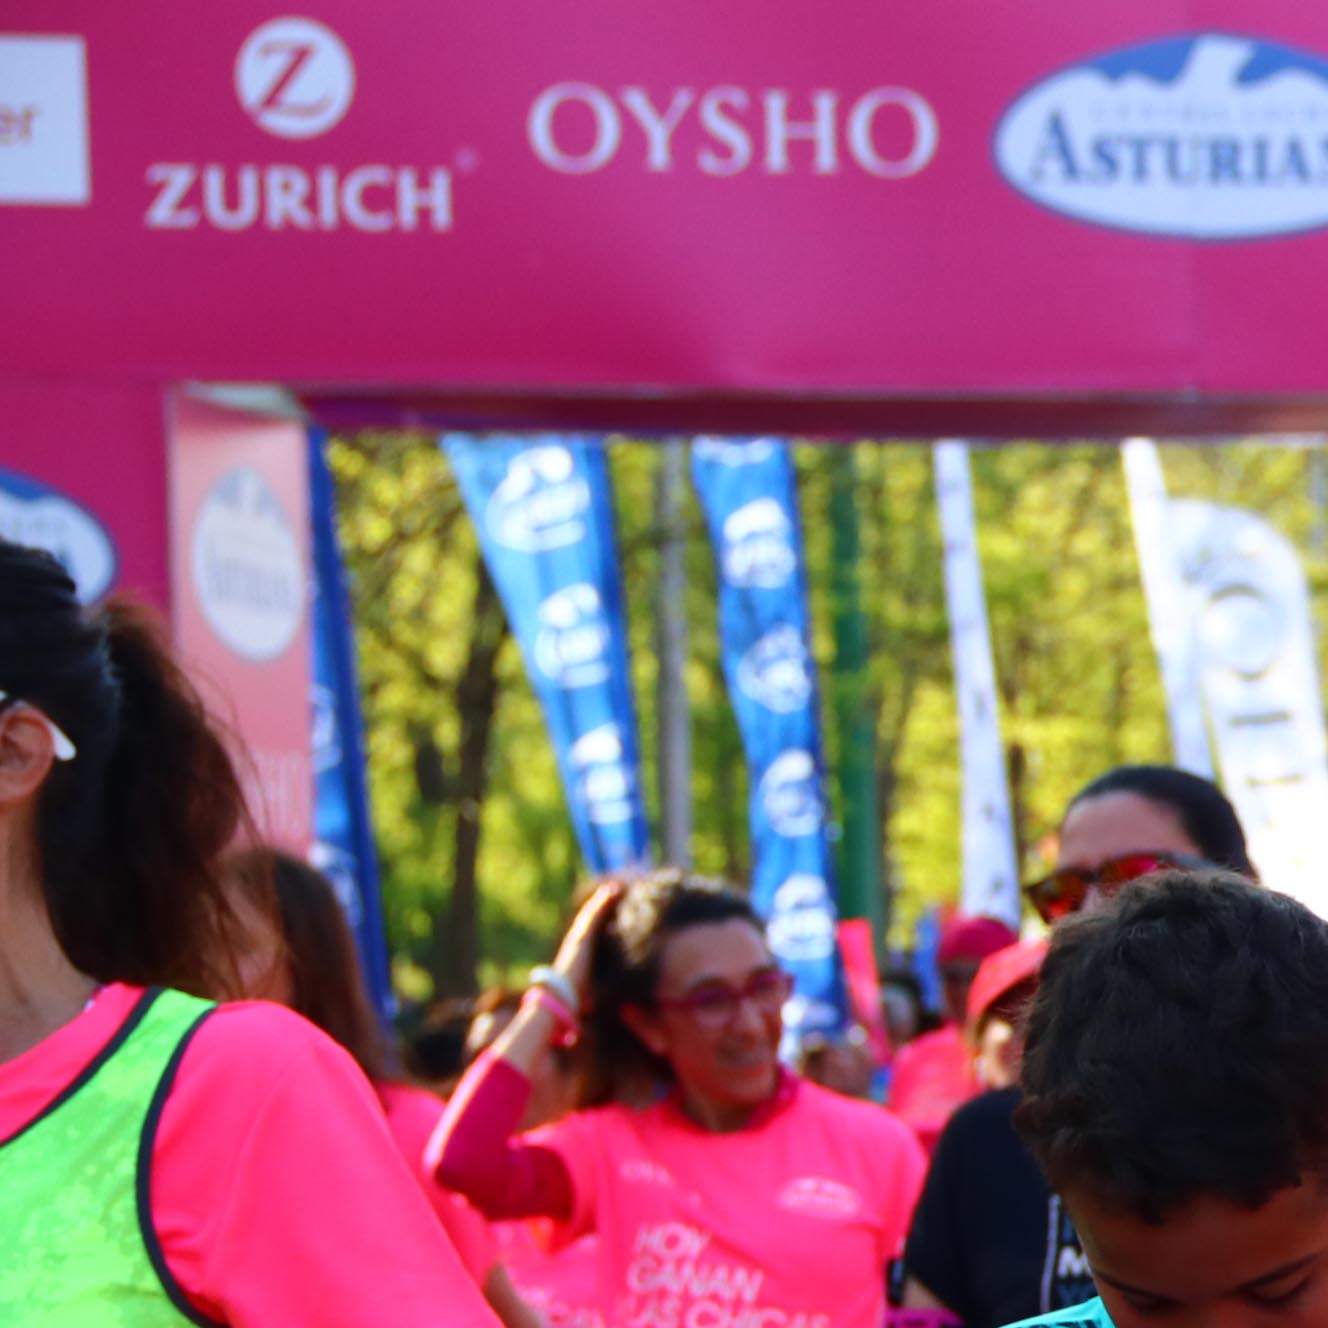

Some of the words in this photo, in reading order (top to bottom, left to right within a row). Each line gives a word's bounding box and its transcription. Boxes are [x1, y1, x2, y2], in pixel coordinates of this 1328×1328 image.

[528, 82, 939, 178] OYSHO
[145, 164, 454, 232] ZURICH
[636, 1221, 712, 1261] HOY
[626, 1255, 765, 1304] GANAN
